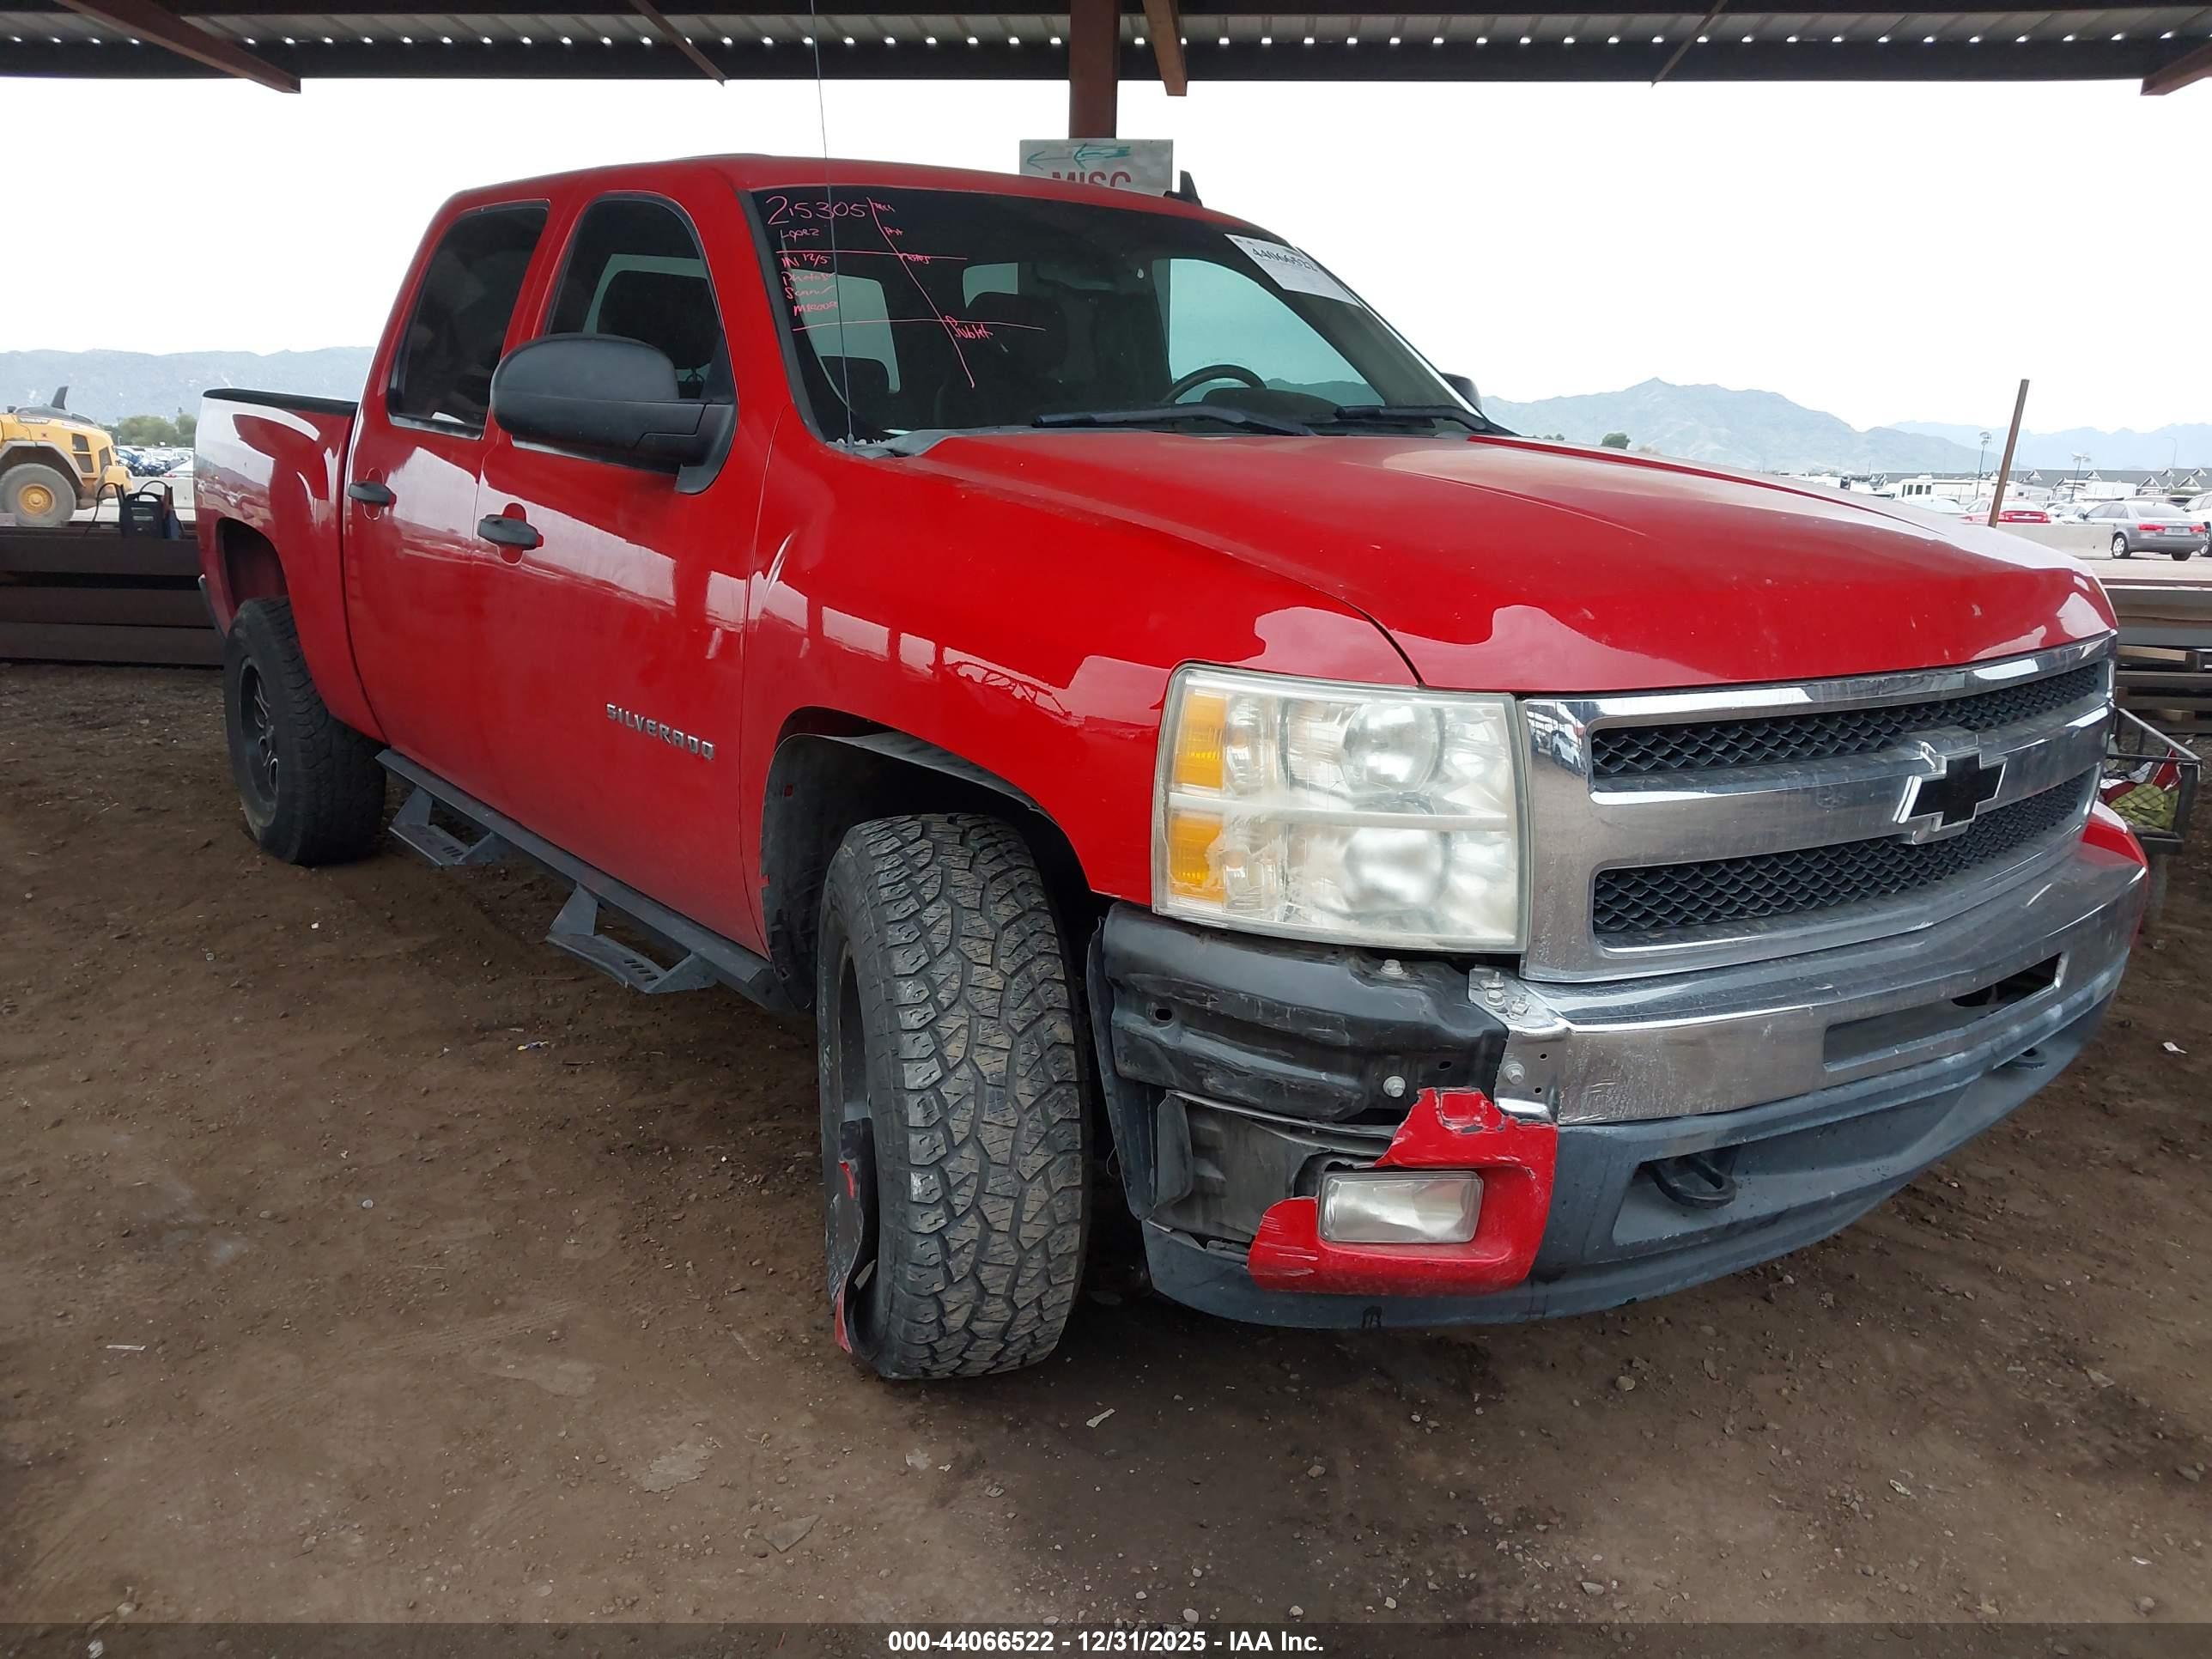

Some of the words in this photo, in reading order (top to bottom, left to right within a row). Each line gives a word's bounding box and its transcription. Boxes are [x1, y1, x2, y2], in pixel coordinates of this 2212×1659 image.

[1052, 172, 1132, 187] SC
[766, 196, 867, 225] 215305
[606, 703, 715, 760] SILVERADO
